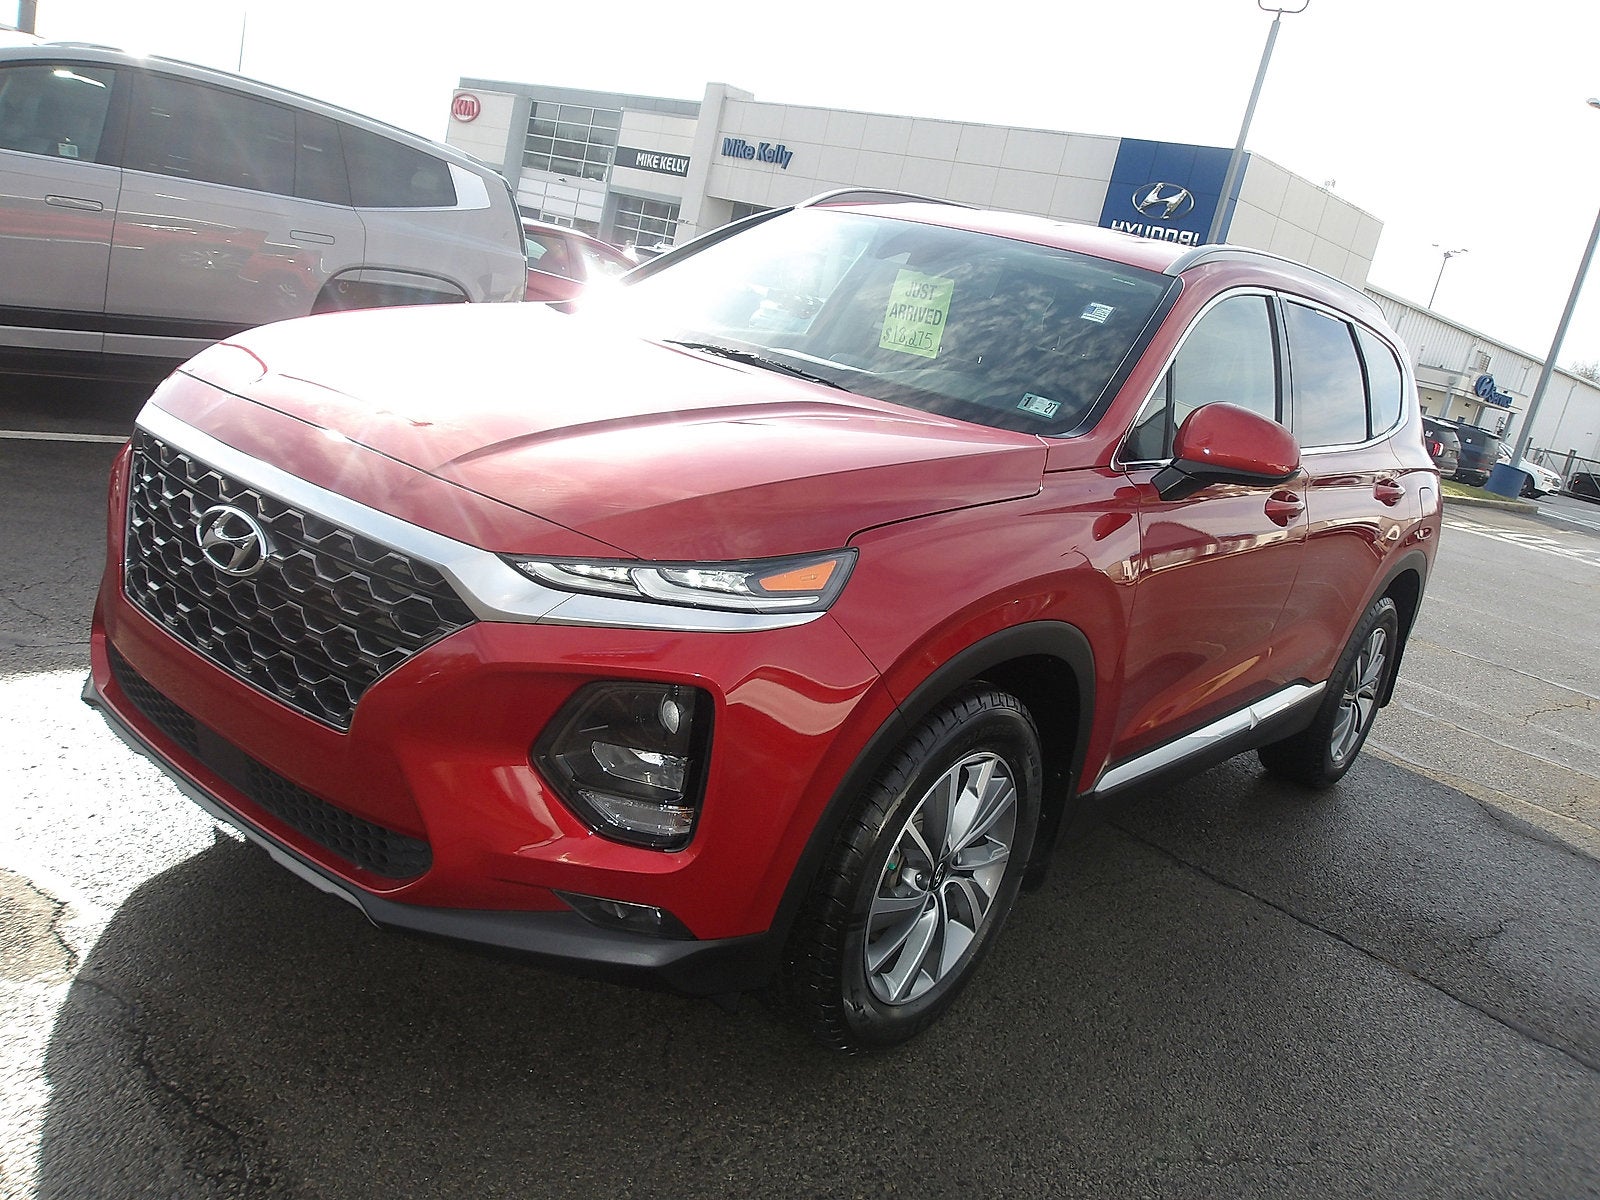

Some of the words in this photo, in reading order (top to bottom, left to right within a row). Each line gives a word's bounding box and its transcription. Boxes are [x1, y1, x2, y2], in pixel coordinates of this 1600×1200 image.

[454, 98, 475, 117] KIA
[636, 152, 660, 169] MIKE
[659, 156, 689, 173] KELLY
[721, 137, 756, 160] Mike
[755, 142, 793, 170] Kelly
[905, 281, 938, 301] JUST
[889, 302, 943, 326] ARRIVED
